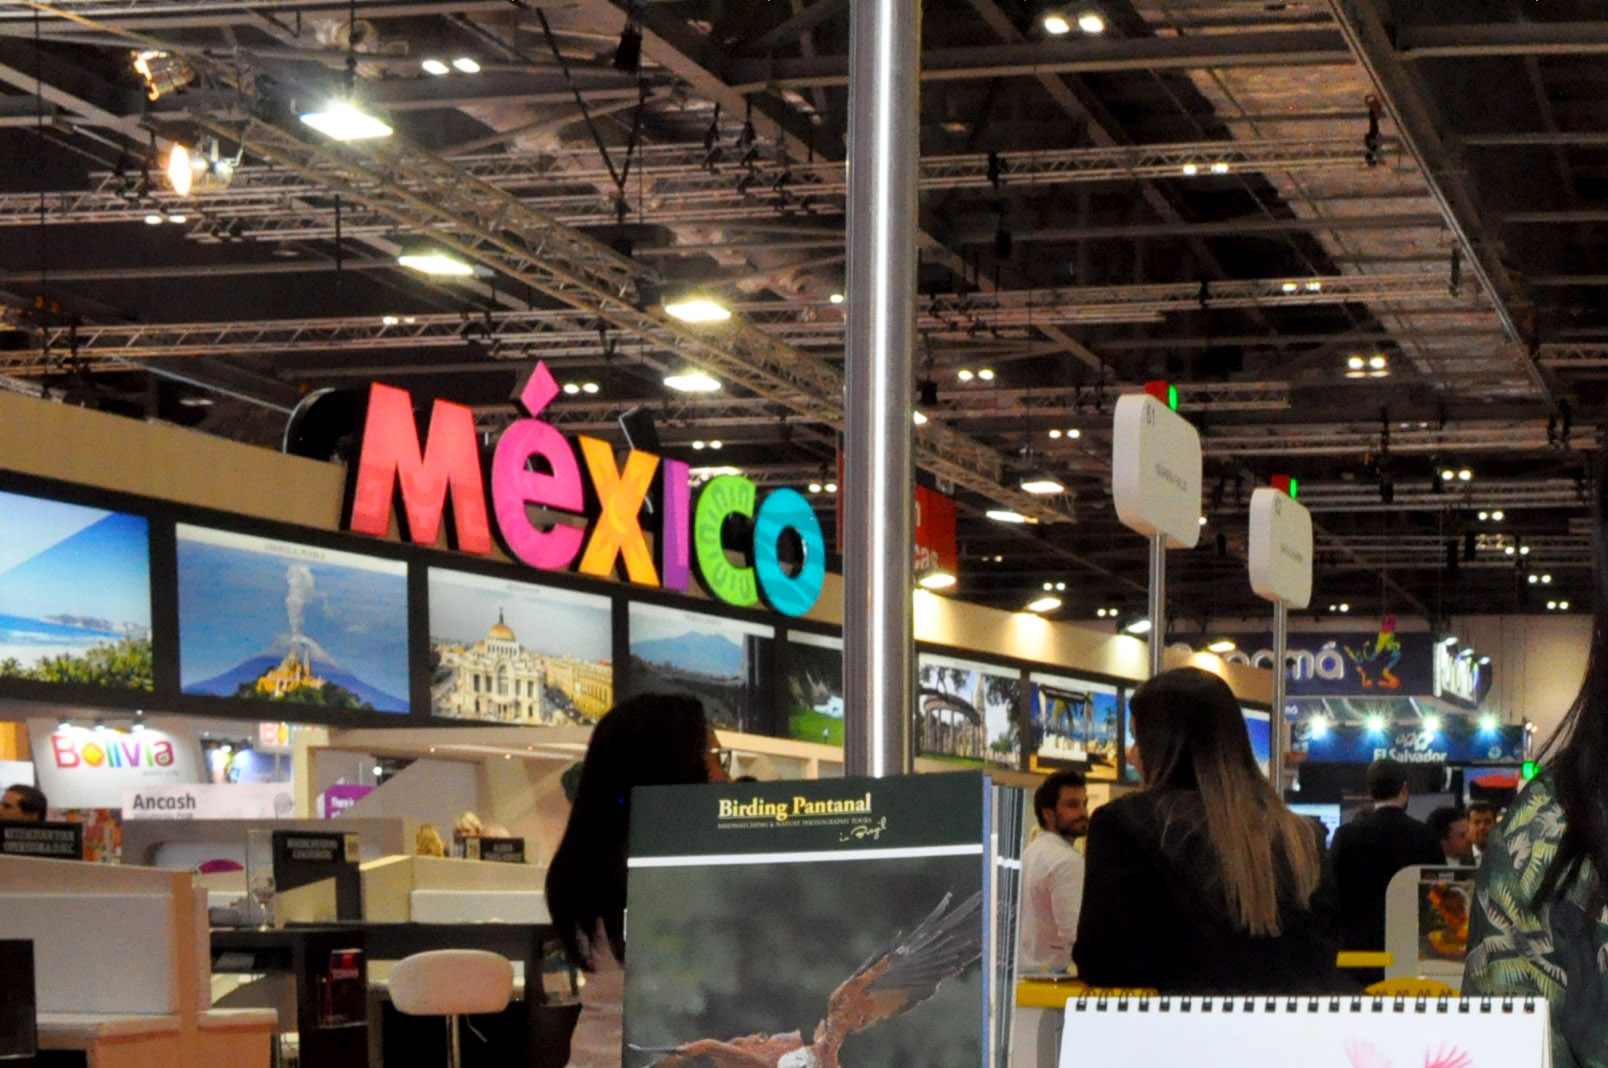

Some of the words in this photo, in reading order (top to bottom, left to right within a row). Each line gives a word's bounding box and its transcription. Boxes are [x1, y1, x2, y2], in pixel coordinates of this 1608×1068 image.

[52, 735, 175, 768] Bolivia
[1390, 748, 1447, 762] Salvador
[132, 793, 197, 811] Ancash
[719, 798, 788, 821] Birding
[792, 792, 872, 815] Pantanal
